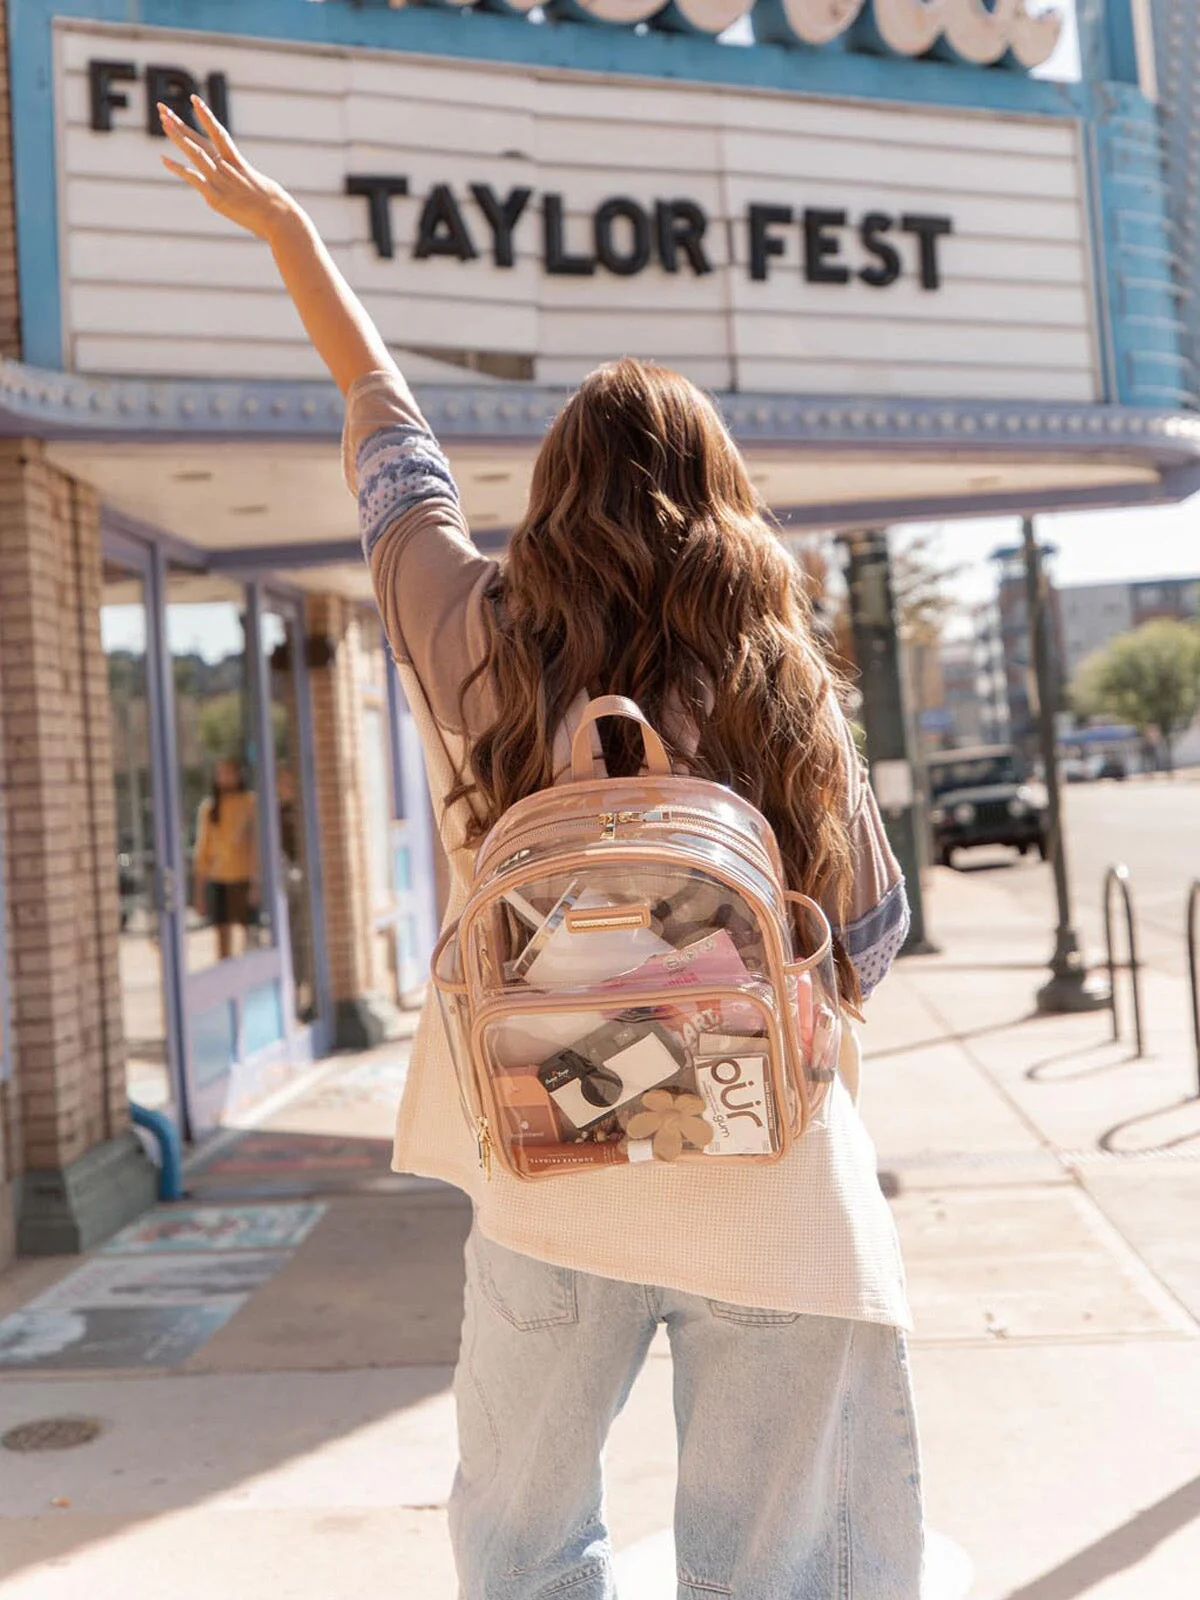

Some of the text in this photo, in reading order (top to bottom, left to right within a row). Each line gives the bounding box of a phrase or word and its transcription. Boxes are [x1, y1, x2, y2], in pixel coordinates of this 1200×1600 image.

[88, 60, 231, 138] FRI
[345, 174, 952, 290] TAYLOR FEST
[712, 1114, 731, 1138] gum
